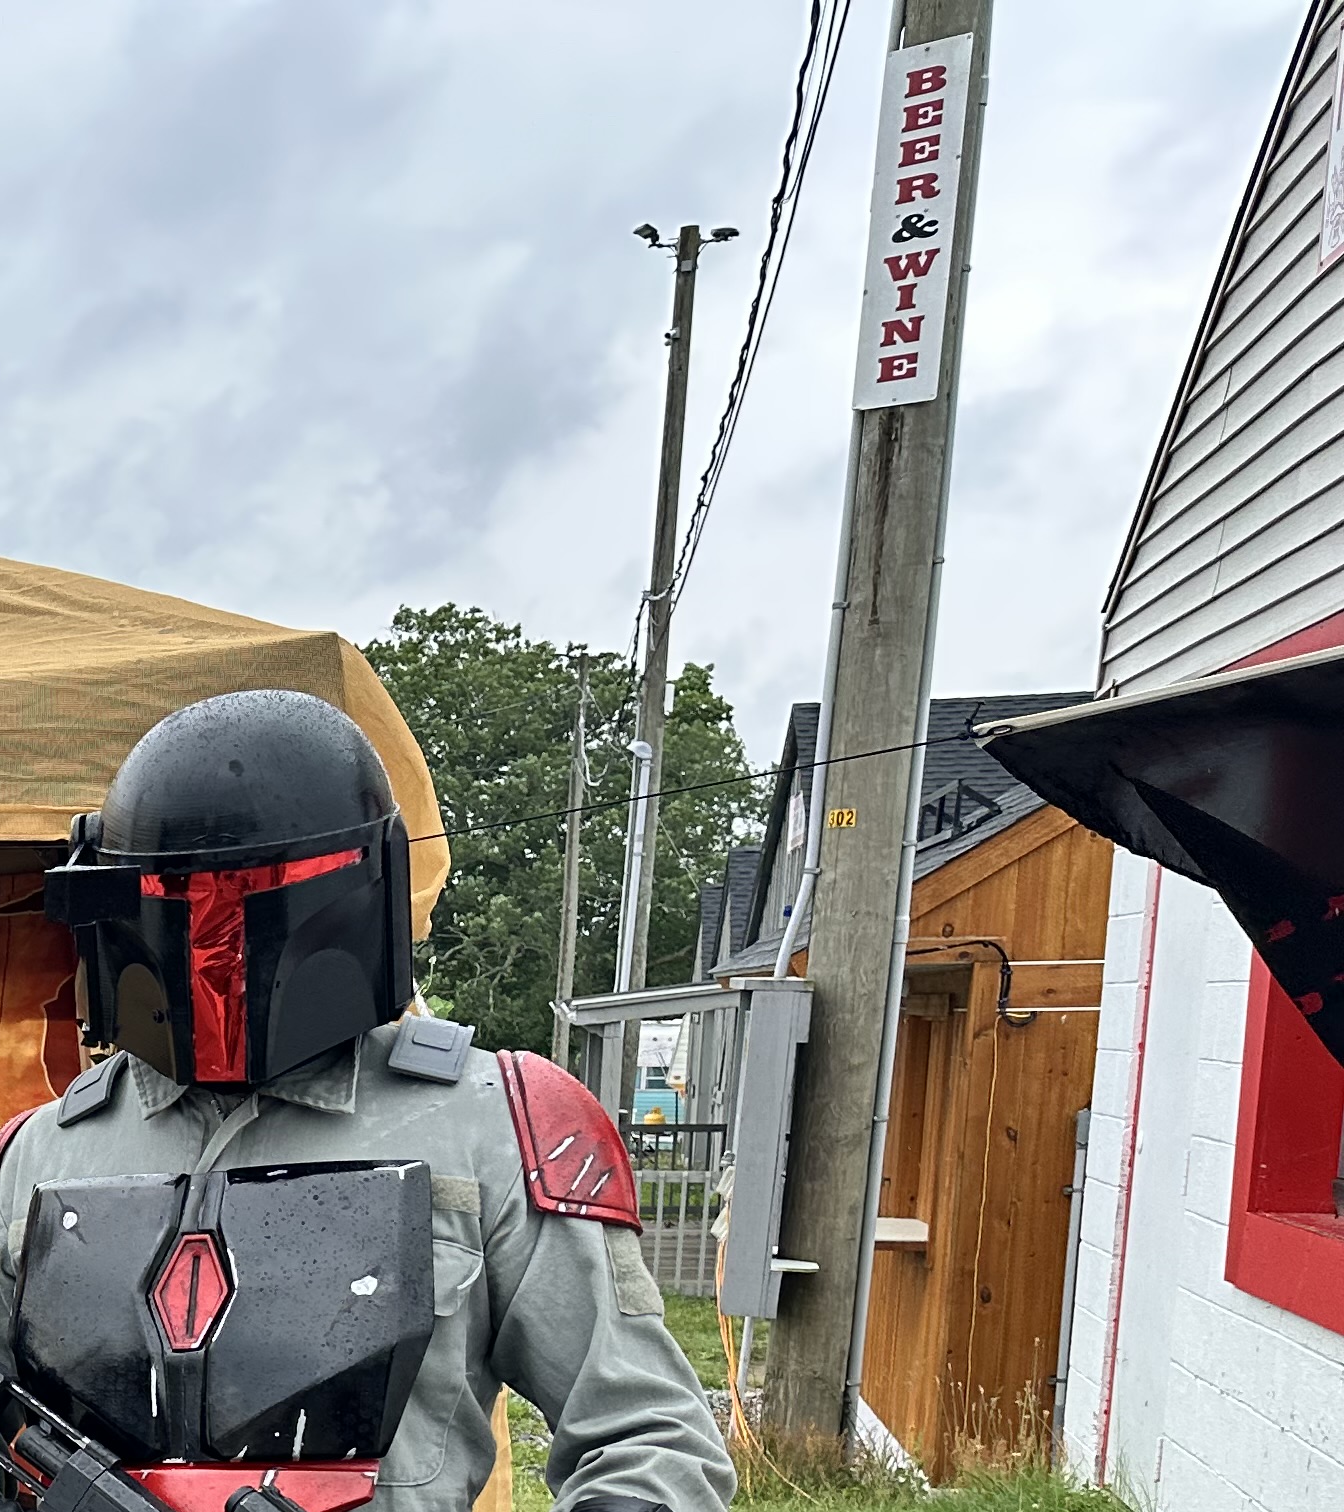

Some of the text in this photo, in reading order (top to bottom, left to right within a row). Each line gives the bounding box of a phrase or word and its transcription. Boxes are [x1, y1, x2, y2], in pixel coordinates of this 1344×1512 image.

[876, 64, 947, 384] BEER & WINE
[829, 810, 854, 827] 302
